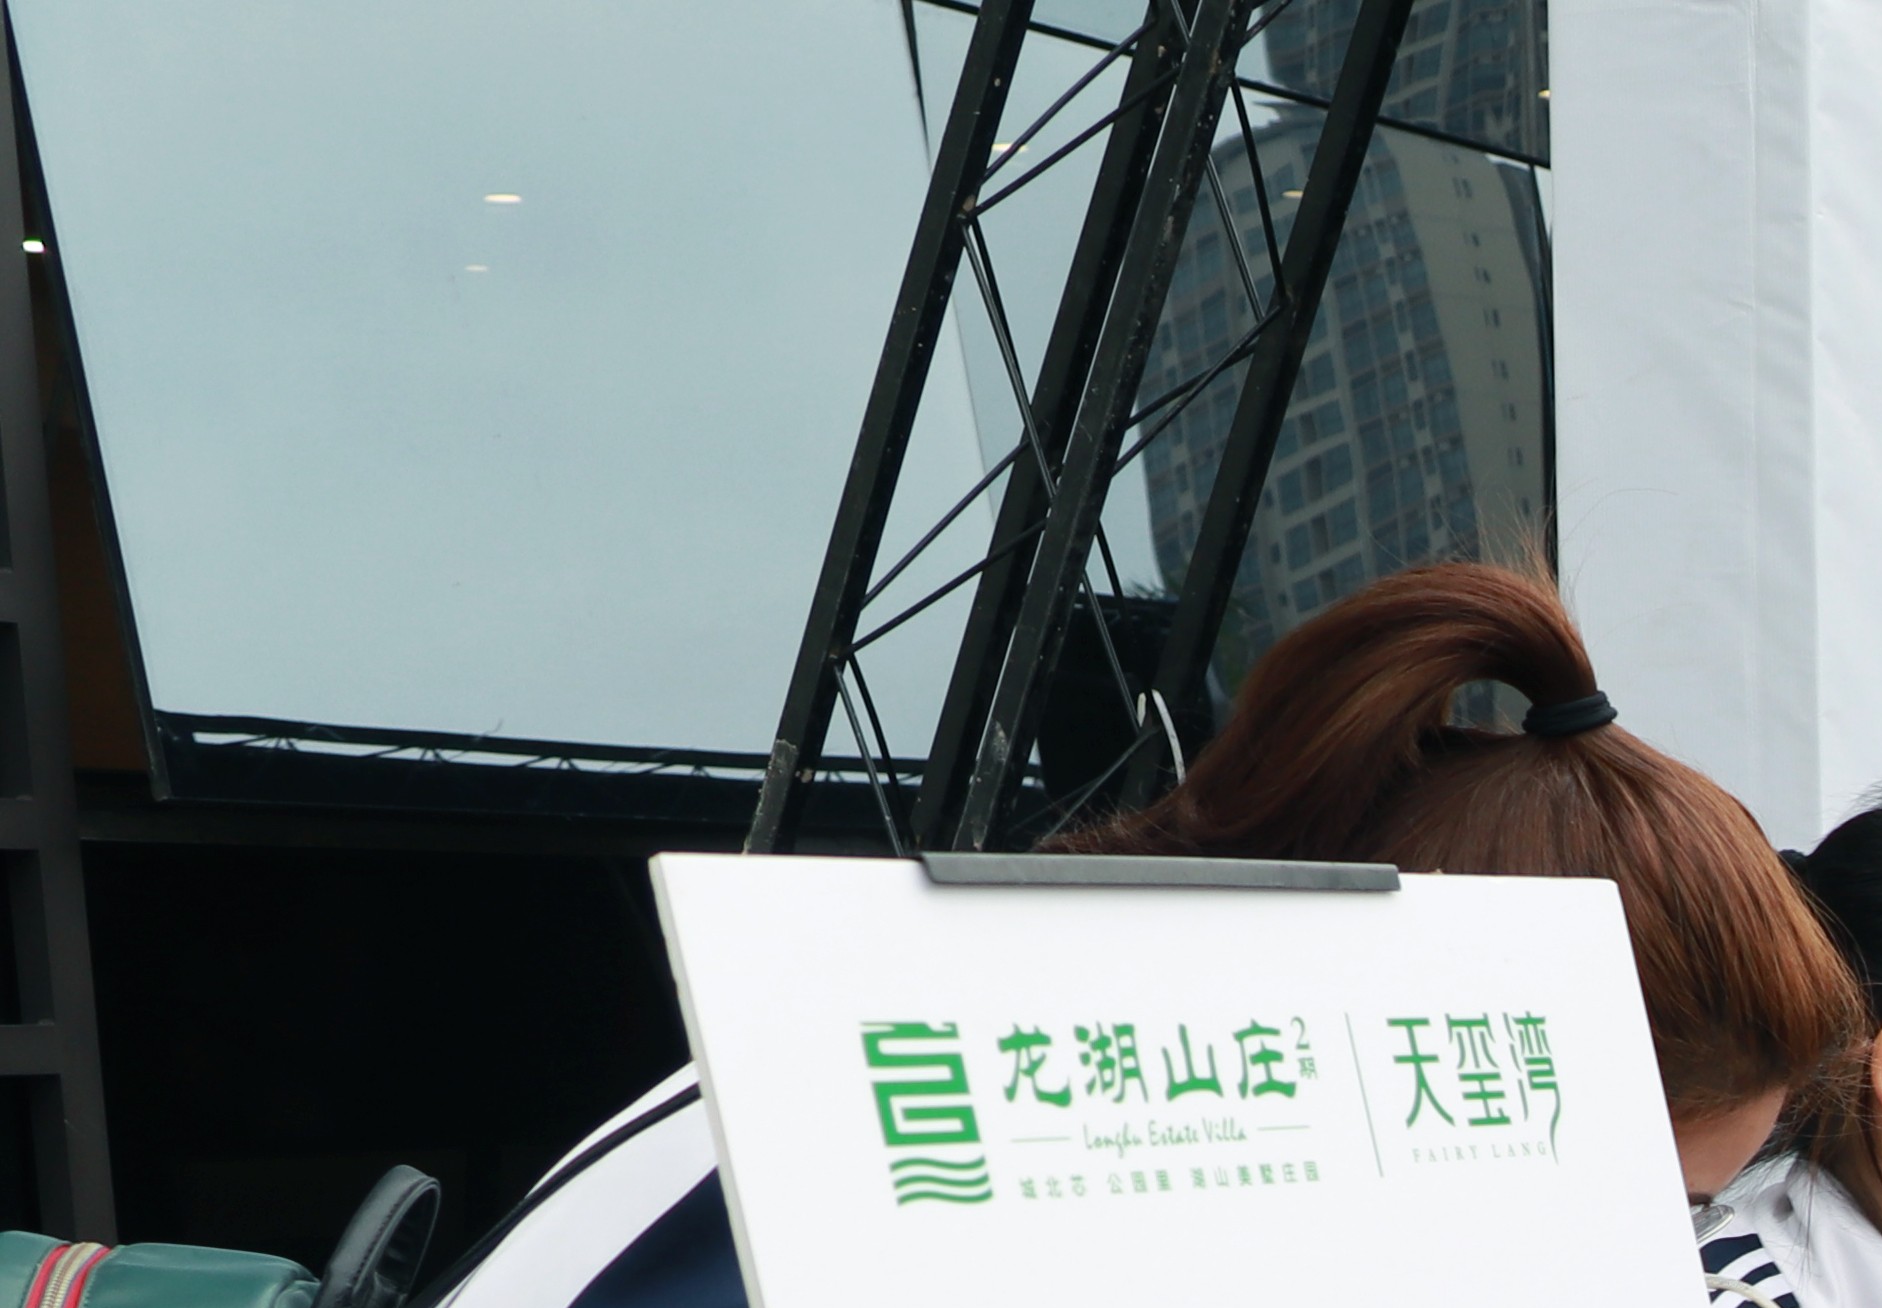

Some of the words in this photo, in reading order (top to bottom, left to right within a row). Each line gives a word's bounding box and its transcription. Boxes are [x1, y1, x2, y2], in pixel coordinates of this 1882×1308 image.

[998, 1018, 1297, 1108] 龙湖山庄
[1386, 1011, 1561, 1165] 天玺湾
[1083, 1121, 1143, 1159] Longhu
[1148, 1119, 1199, 1147] Estate
[1202, 1116, 1247, 1142] Villa
[1412, 1145, 1479, 1164] FAIRY
[1107, 1169, 1172, 1195] 公园里
